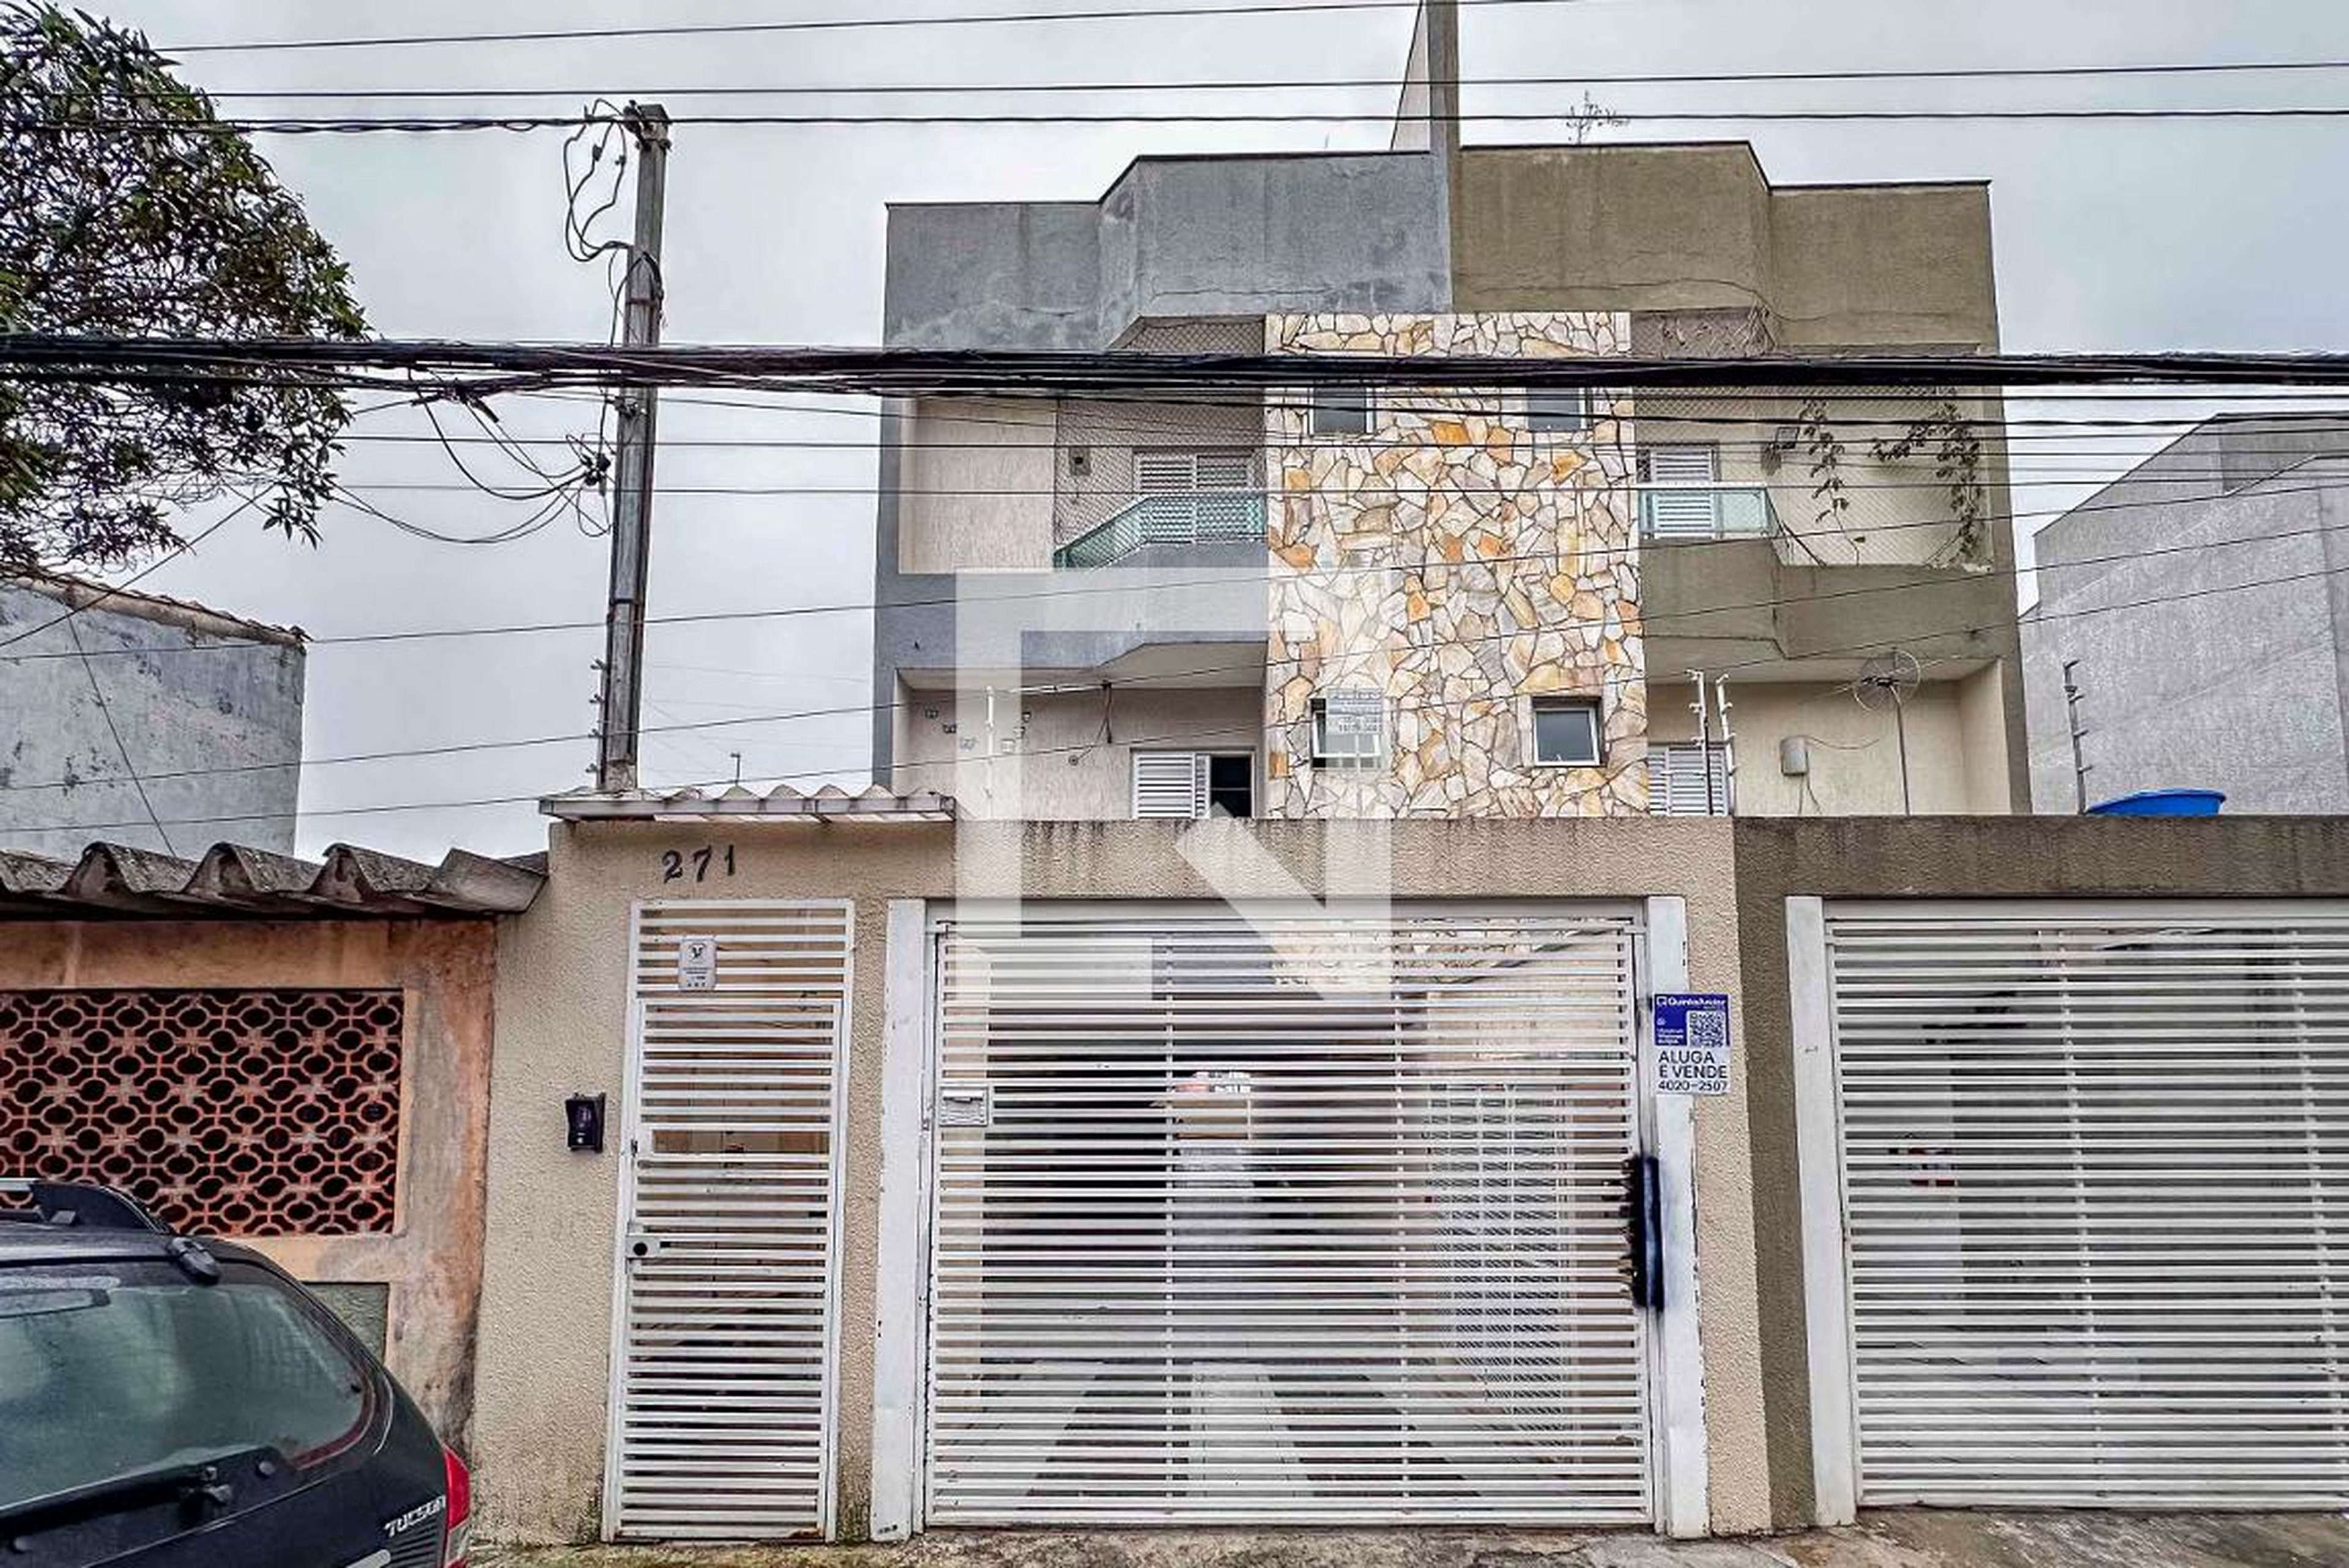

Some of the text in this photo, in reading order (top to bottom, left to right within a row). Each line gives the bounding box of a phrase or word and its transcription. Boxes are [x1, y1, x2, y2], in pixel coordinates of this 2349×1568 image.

[661, 844, 735, 884] 271
[1658, 1050, 1715, 1064] ALUGA
[1659, 1065, 1728, 1079] E VENDE
[384, 1494, 447, 1538] TUCSON
